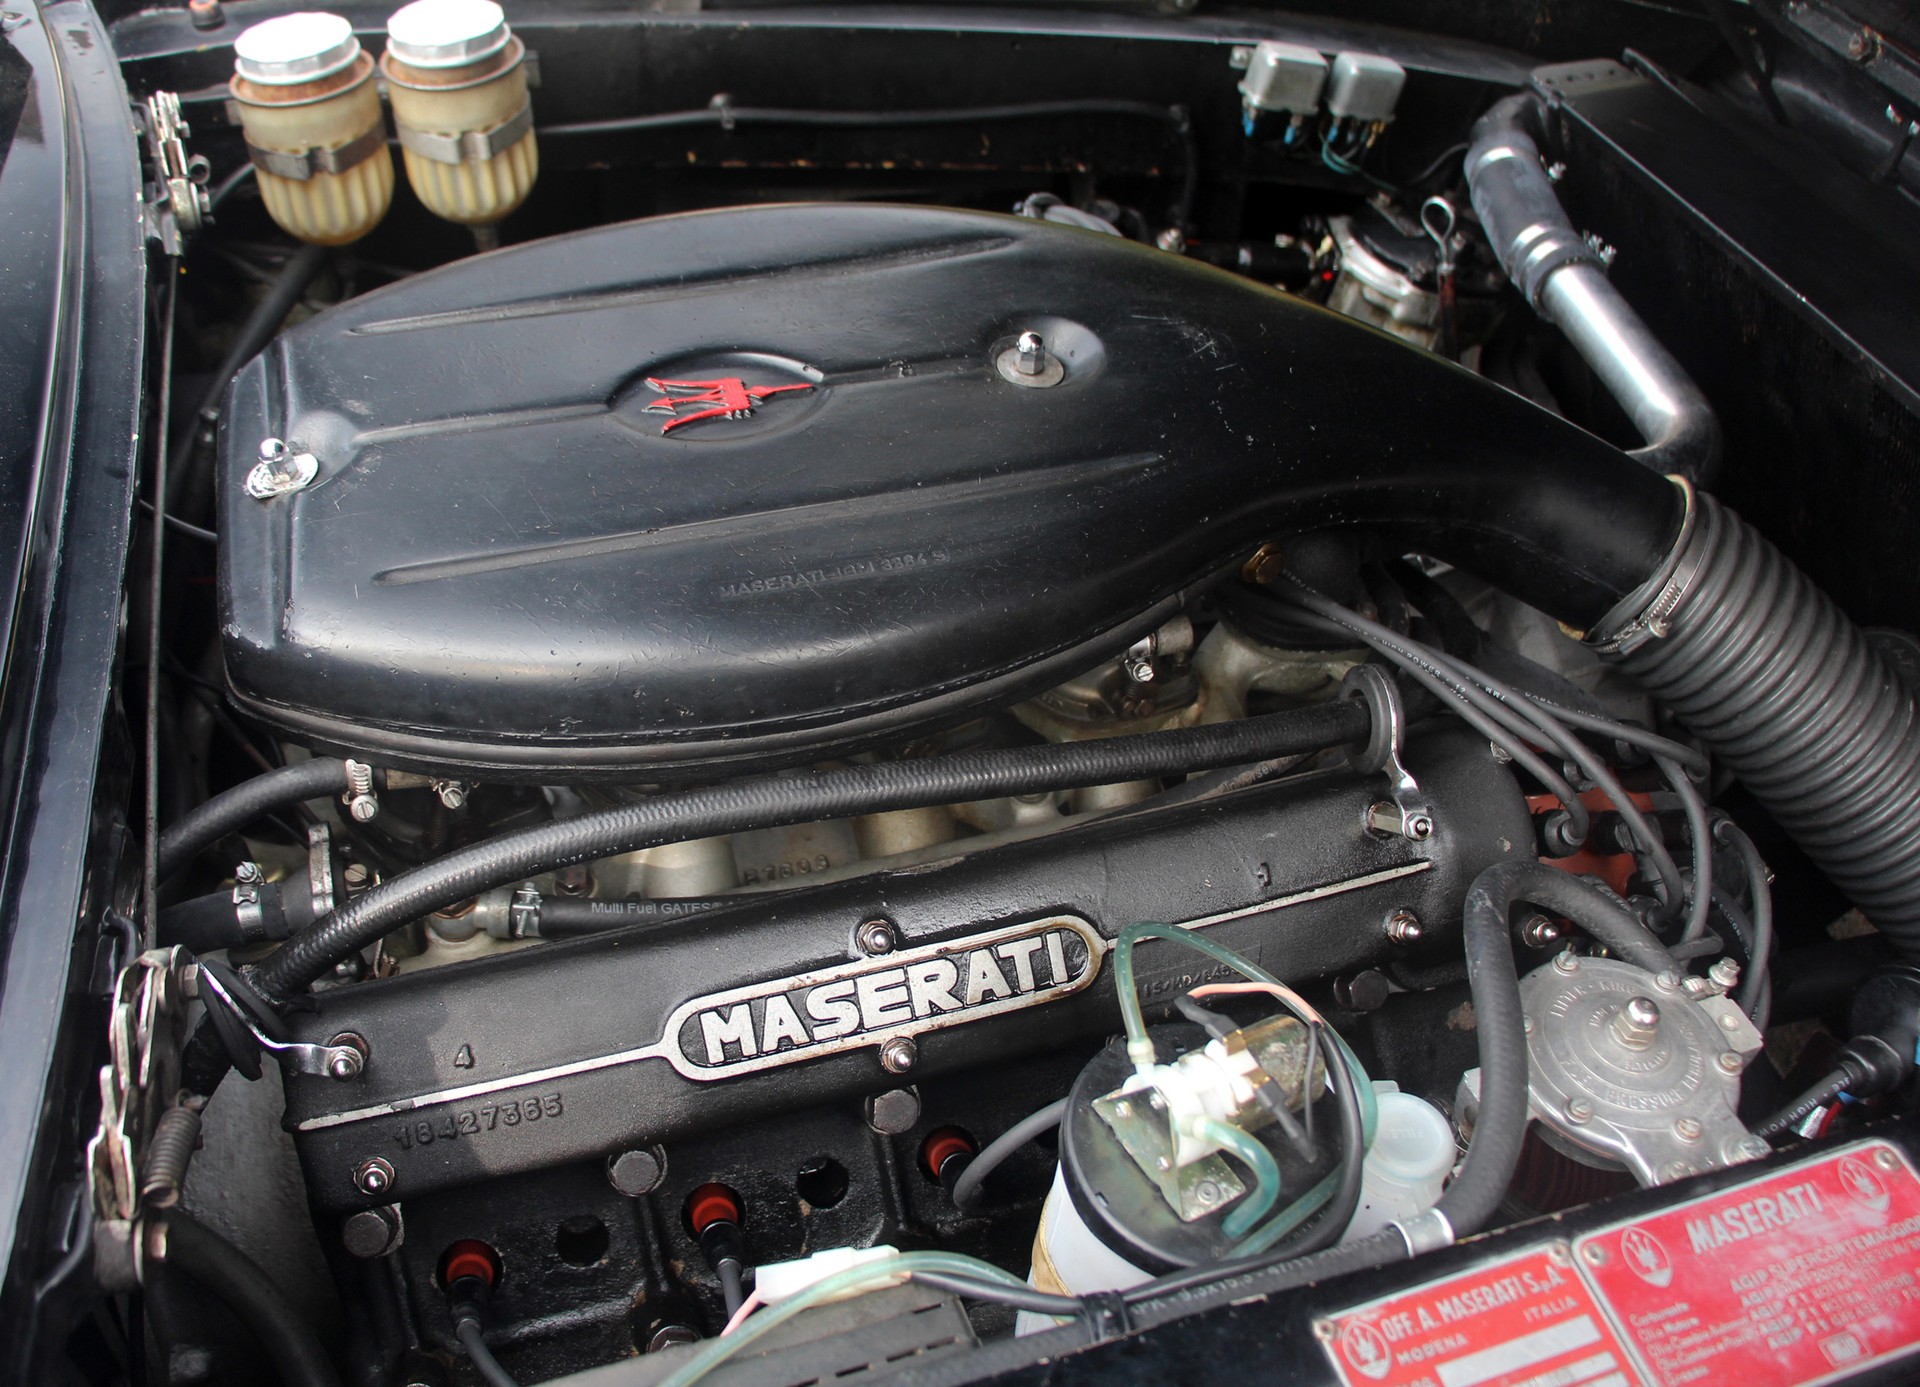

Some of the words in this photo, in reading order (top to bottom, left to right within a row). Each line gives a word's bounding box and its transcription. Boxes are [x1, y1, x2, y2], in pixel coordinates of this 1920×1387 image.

[719, 568, 826, 599] MASERATI
[591, 901, 624, 914] Multi
[627, 902, 657, 914] Fuel
[699, 932, 1070, 1066] MASERATI
[454, 1044, 474, 1069] 4
[394, 1093, 564, 1150] 18427365
[1685, 1182, 1824, 1254] MASERATI
[1730, 1269, 1768, 1293] AGIP
[1380, 1309, 1421, 1342] OFF.
[1435, 1276, 1525, 1323] MASERATI
[1524, 1296, 1578, 1323] ITALIA
[1396, 1333, 1469, 1366] MODENA
